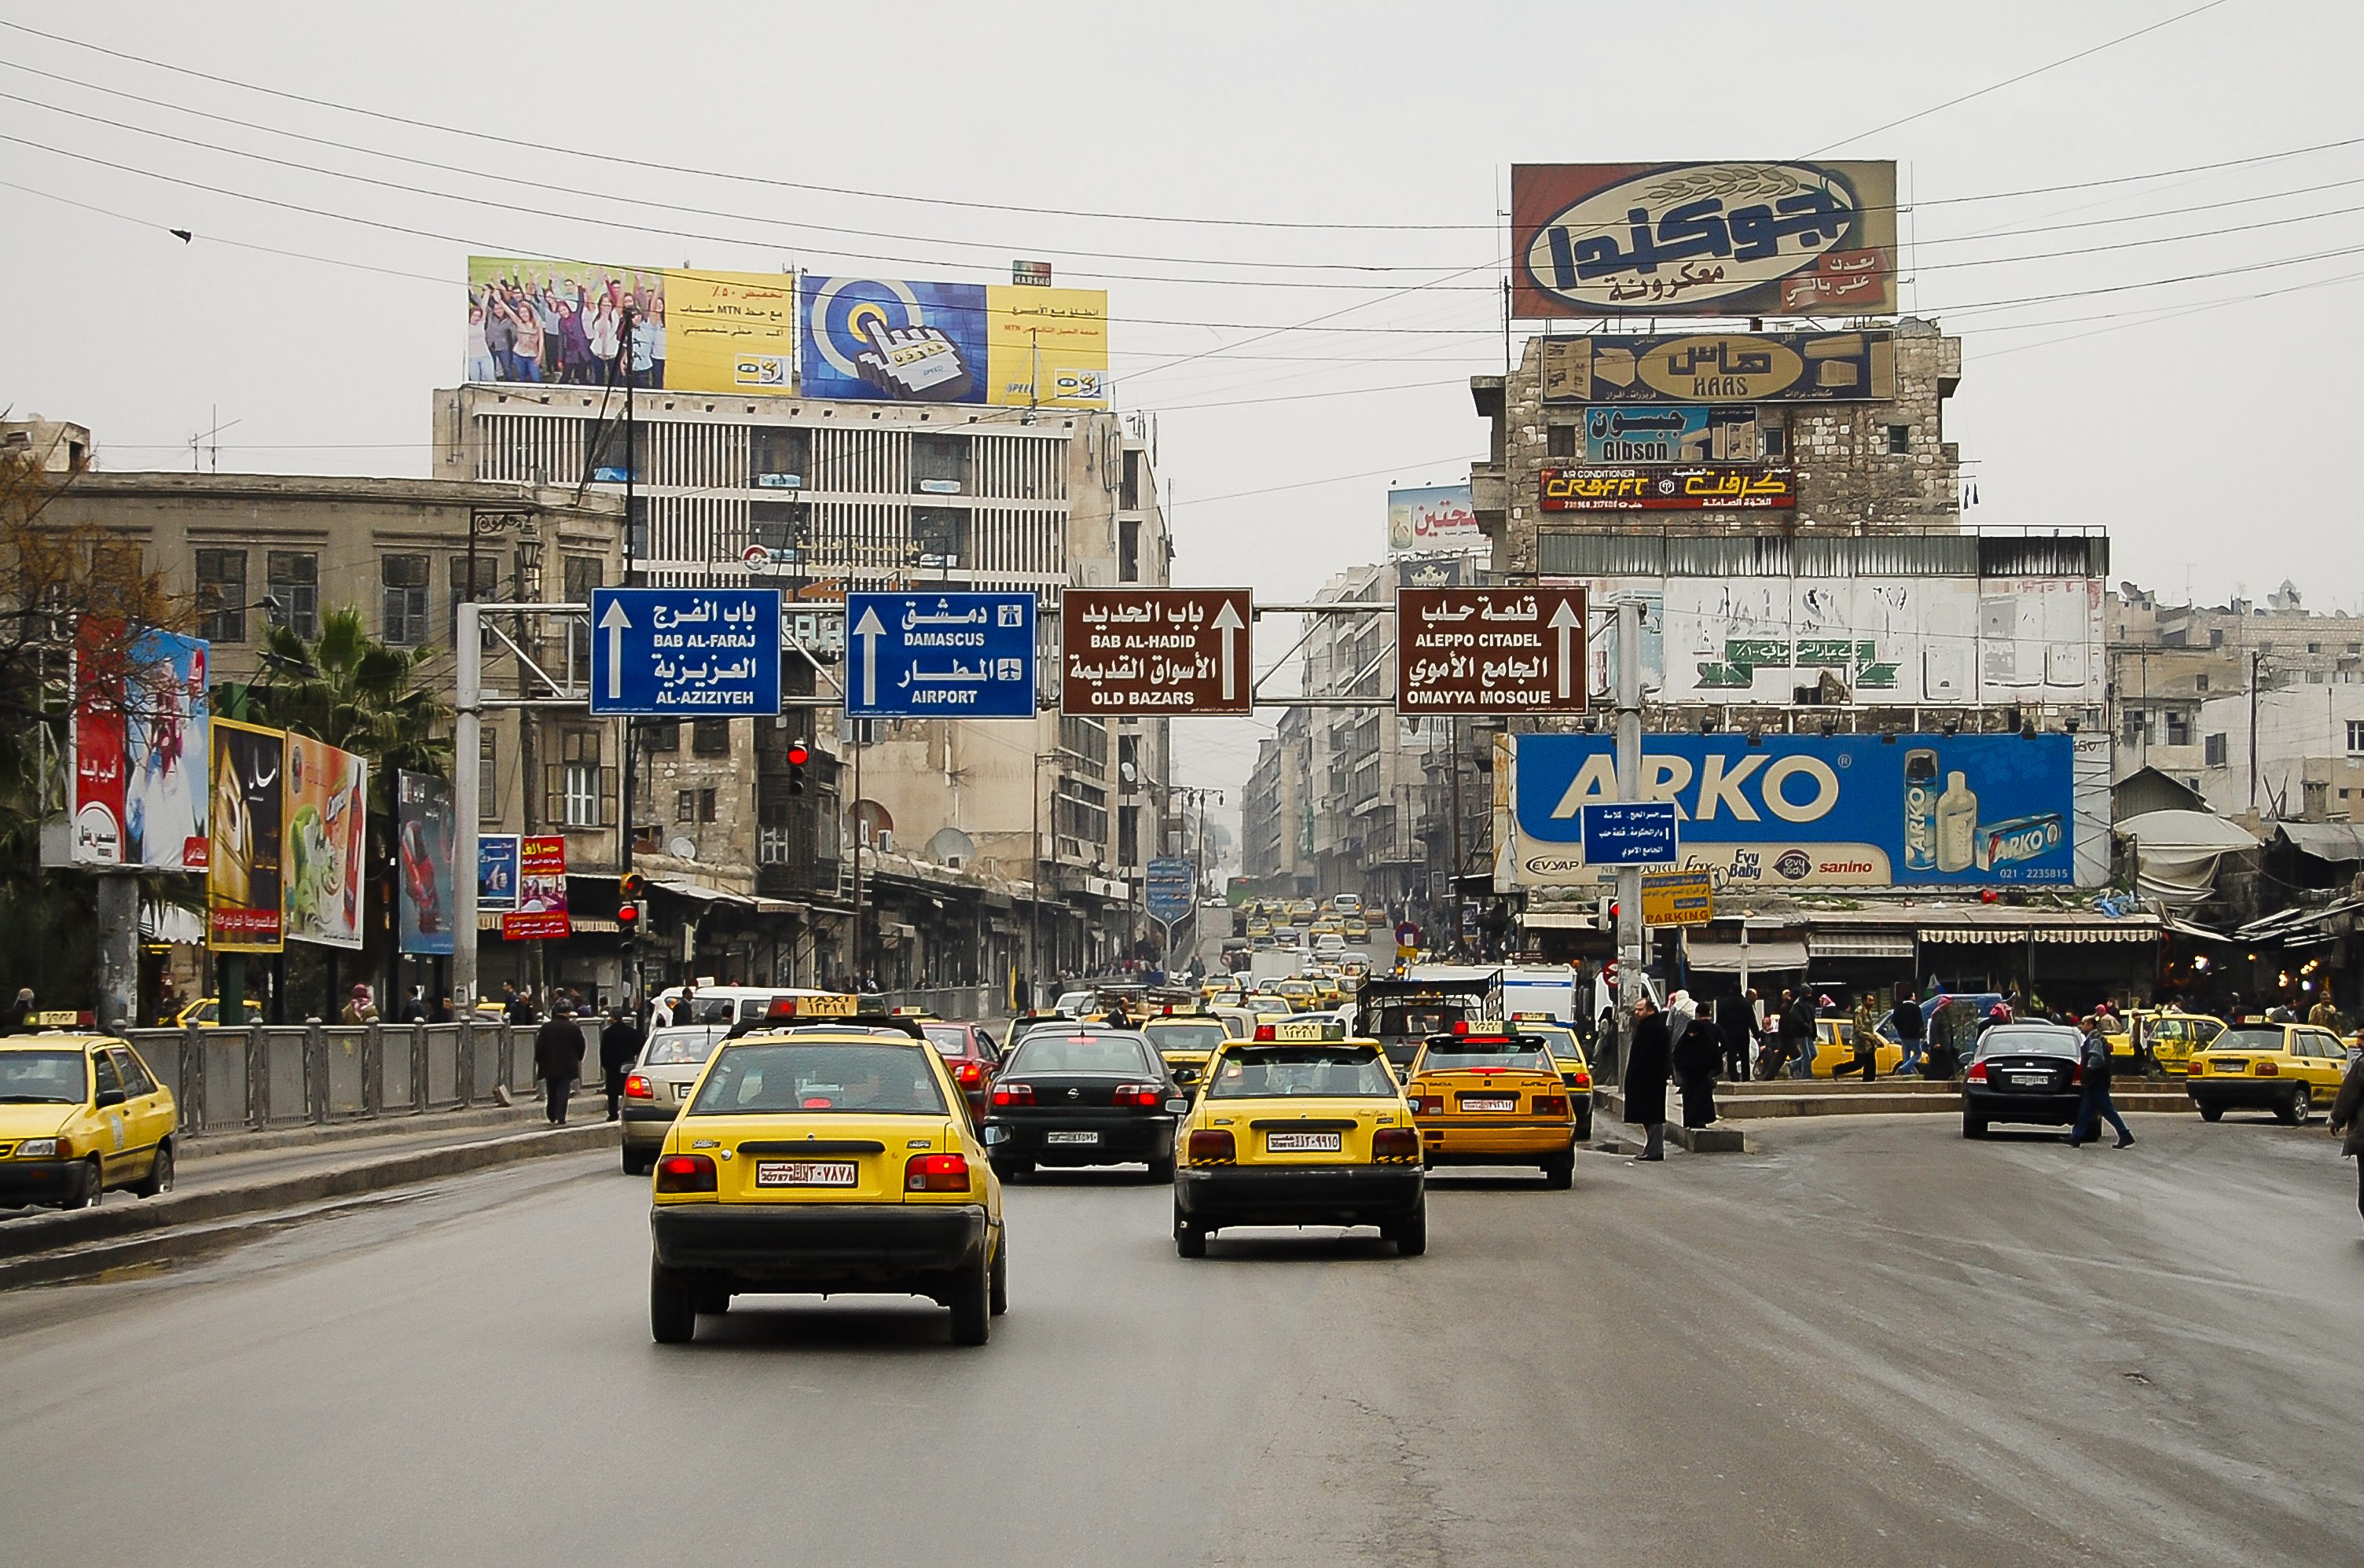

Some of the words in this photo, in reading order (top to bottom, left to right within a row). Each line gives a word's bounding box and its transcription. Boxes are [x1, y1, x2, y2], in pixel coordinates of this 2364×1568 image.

[1547, 189, 1853, 290] جوكندا
[1830, 255, 1874, 270] بعدك
[1604, 262, 1724, 302] معكرونة
[1786, 277, 1830, 307] بالي
[718, 305, 741, 315] MTN
[770, 310, 782, 321] مع
[1668, 340, 1771, 375] هاس
[1693, 376, 1749, 396] HAAS
[1591, 411, 1687, 439] جبسون
[1685, 470, 1786, 498] كرافت
[654, 598, 718, 629] الفرج
[724, 600, 755, 630] باب
[902, 598, 987, 630] دمشق
[1083, 600, 1159, 630] الحديد
[1168, 600, 1203, 631] باب
[1422, 600, 1475, 629] حلب
[1478, 595, 1537, 621] قلعة
[654, 634, 683, 647] BAB
[687, 634, 755, 647] AL-FARAJ
[905, 633, 984, 645] DAMASCUS
[1091, 635, 1121, 648] BAB
[1125, 635, 1195, 648] AL-HADID
[1415, 633, 1474, 647] ALEPPO
[1478, 633, 1541, 647] CITADEL
[652, 654, 755, 688] العزيزية
[897, 659, 993, 688] المطار
[1070, 654, 1143, 686] القديمة
[1151, 651, 1216, 685] الأسواق
[1409, 650, 1474, 687] الأموي
[1481, 655, 1547, 687] الجامع
[656, 692, 753, 704] AL-AZIZIYEH
[912, 691, 977, 703] AIRPORT
[1092, 692, 1124, 705] OLD
[1129, 692, 1194, 705] BAZARS
[1407, 691, 1475, 704] OMAYYA
[1480, 691, 1551, 704] MOSQUE
[1551, 753, 1839, 823] ARKO
[1910, 788, 1925, 852] ARKO
[1533, 861, 1580, 871] EVYAP
[1735, 849, 1760, 865] Evy
[1819, 860, 1872, 873] sanino
[1730, 863, 1761, 880] Baby
[2000, 869, 2017, 878] 021
[2026, 869, 2068, 878] 2235815
[1646, 910, 1709, 924] PARKING
